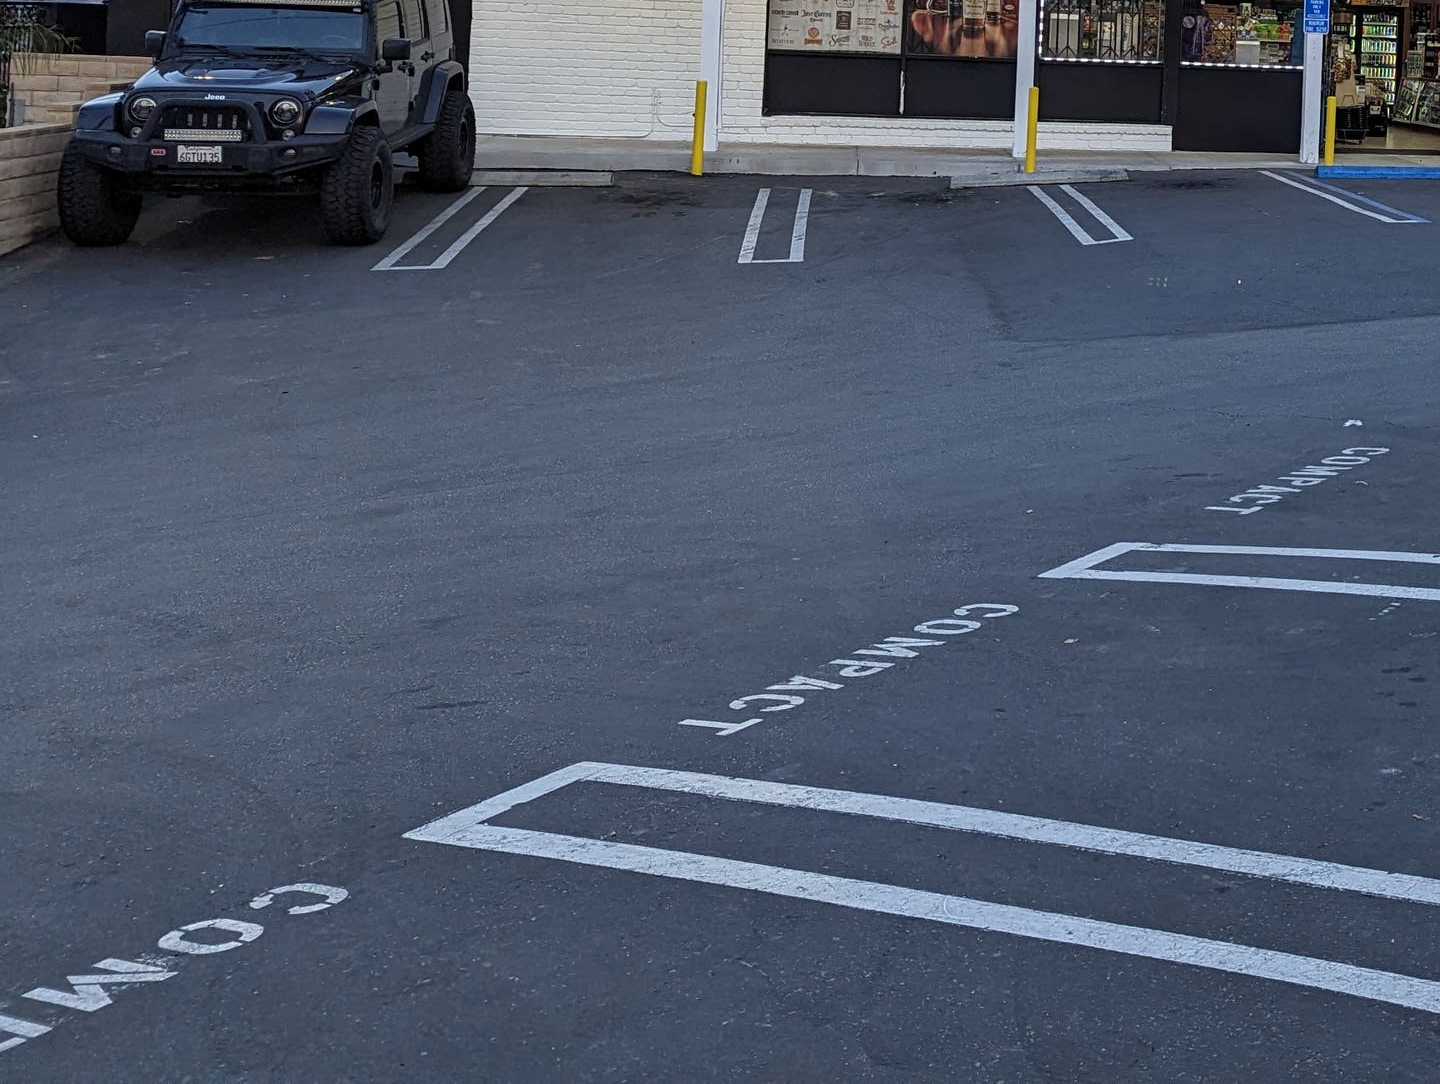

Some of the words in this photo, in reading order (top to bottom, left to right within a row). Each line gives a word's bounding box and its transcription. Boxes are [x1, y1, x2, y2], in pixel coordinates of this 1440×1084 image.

[179, 152, 220, 163] 6GTU135
[1204, 447, 1390, 515] COMPACT
[677, 603, 1020, 737] COMPACT
